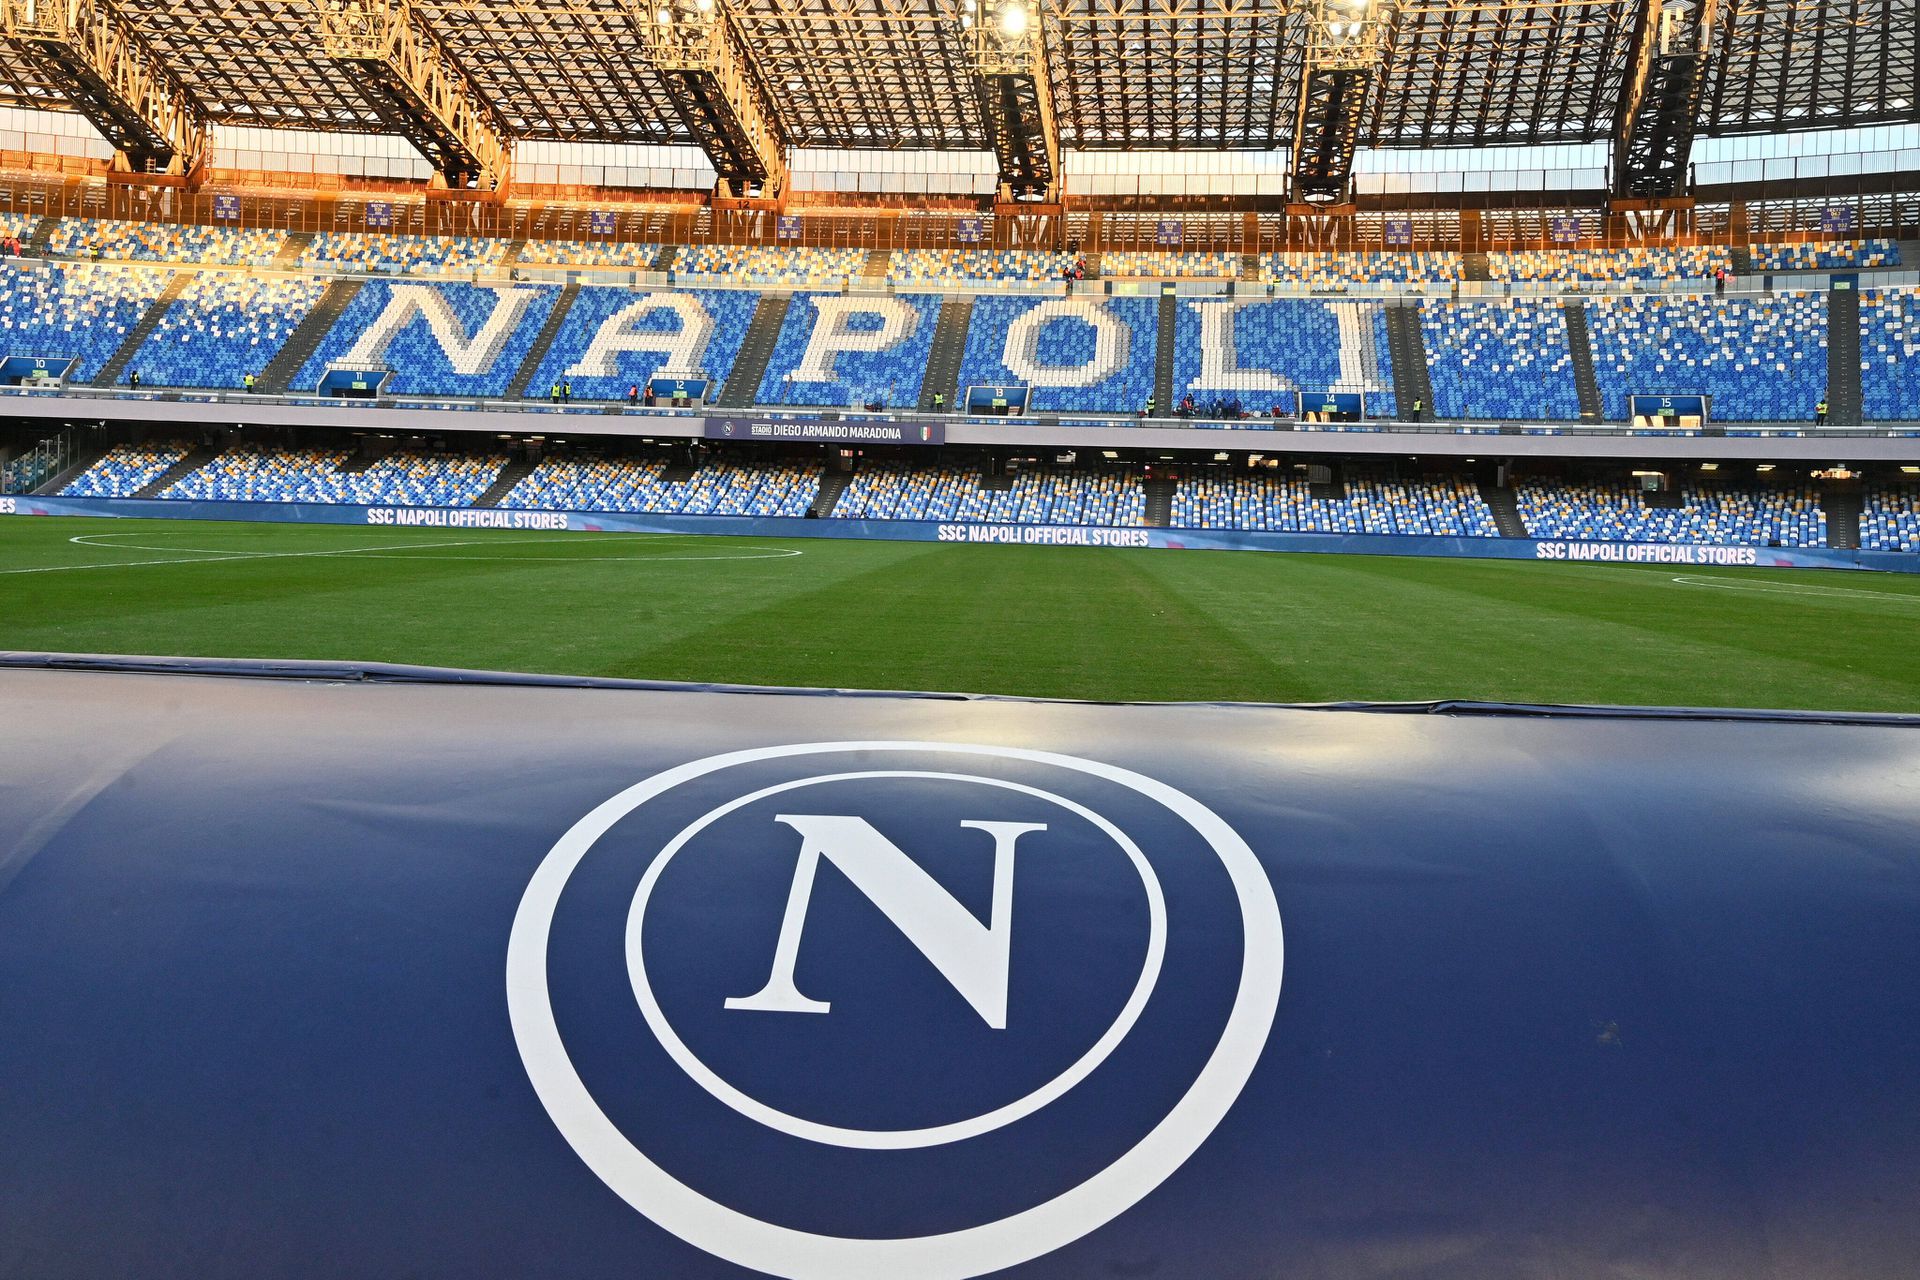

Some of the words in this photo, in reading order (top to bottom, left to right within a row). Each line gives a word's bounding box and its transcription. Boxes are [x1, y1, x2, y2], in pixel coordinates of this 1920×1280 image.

[737, 200, 750, 209] 12
[1019, 206, 1032, 214] 13
[326, 284, 1381, 393] NAPOLI
[35, 359, 45, 368] 10
[356, 372, 363, 380] 11
[675, 380, 685, 389] 12
[995, 388, 1003, 397] 13
[1325, 394, 1335, 403] 14
[1661, 398, 1671, 407] 15
[752, 425, 772, 434] STADIO
[773, 424, 801, 436] DIEGO
[802, 425, 848, 438] ARMANDO
[849, 426, 901, 439] MARADONA
[0, 498, 16, 513] ES
[367, 508, 394, 524] SSC
[397, 509, 446, 525] NAPOLI
[449, 511, 511, 528] OFFICIAL
[514, 513, 567, 529] STORES
[938, 525, 966, 541] SSC
[969, 526, 1021, 543] NAPOLI
[1025, 527, 1089, 545] OFFICIAL
[1092, 528, 1148, 546] STORES
[1536, 542, 1565, 558] SSC
[1568, 543, 1623, 560] NAPOLI
[1626, 545, 1694, 563] OFFICIAL
[1697, 546, 1756, 564] STORES
[724, 814, 1048, 1030] N
